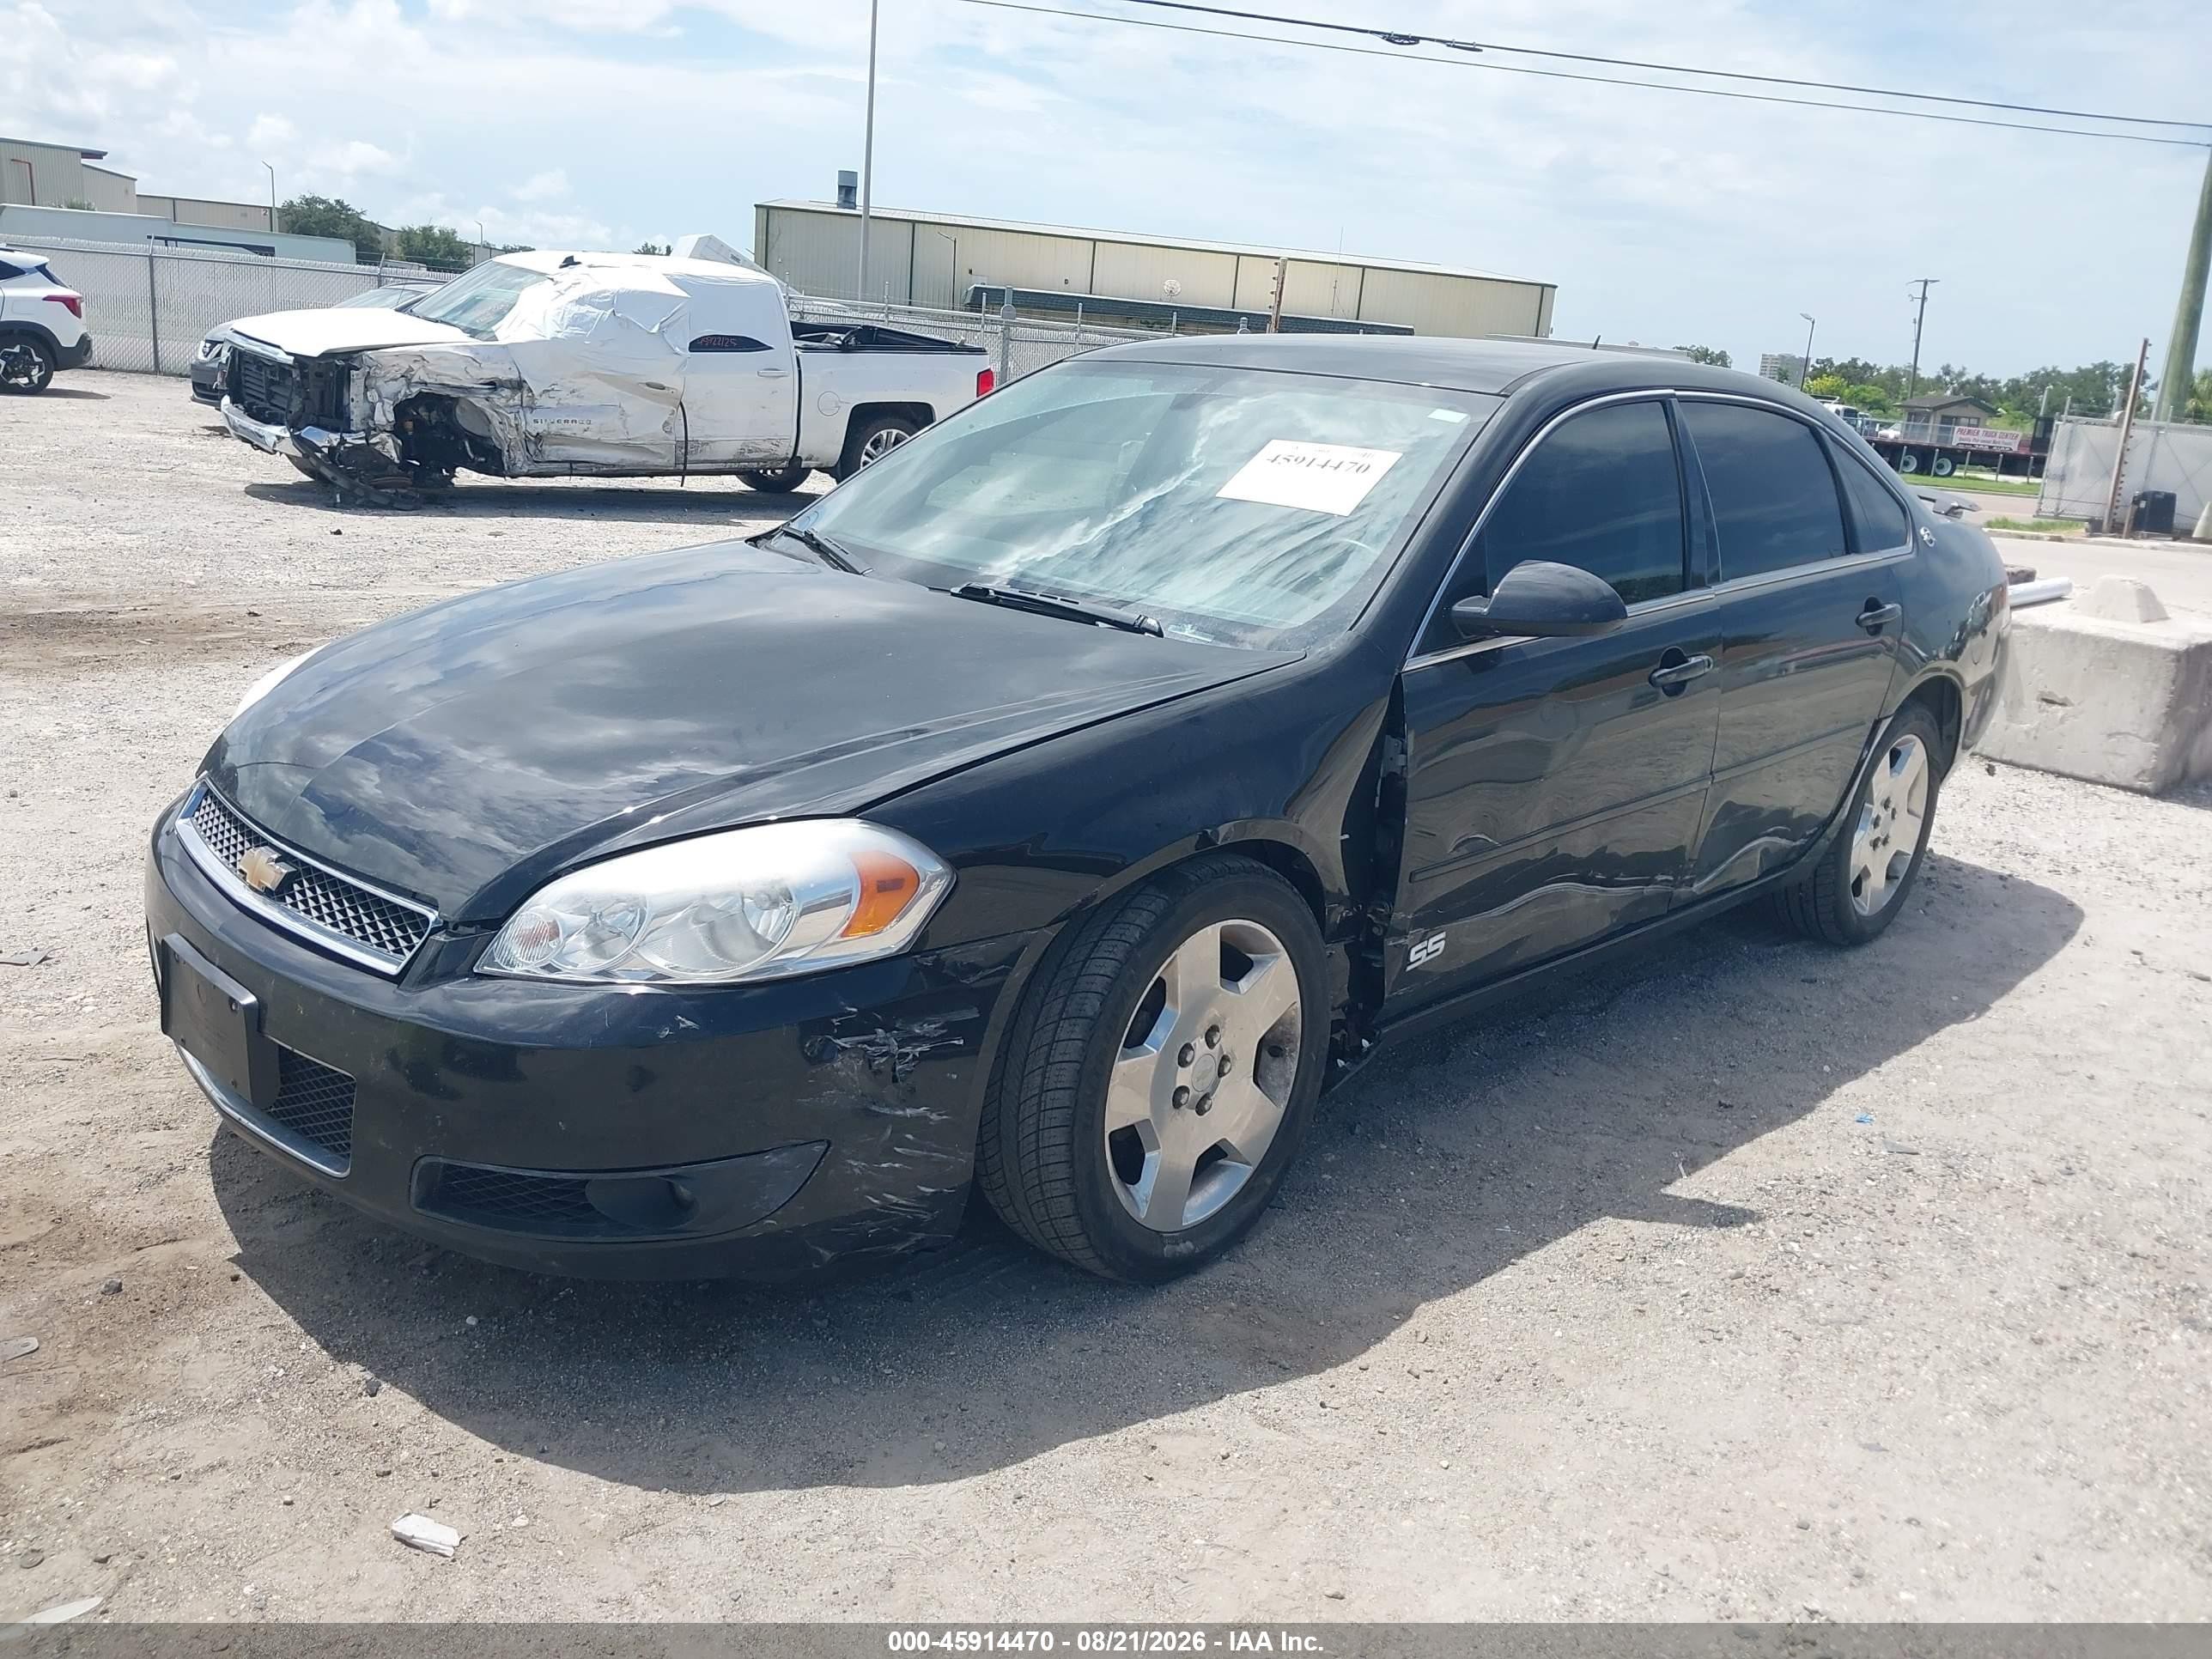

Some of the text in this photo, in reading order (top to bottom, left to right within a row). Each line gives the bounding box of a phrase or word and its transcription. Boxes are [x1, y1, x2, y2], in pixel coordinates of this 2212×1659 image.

[1957, 428, 1979, 436] PREMIER
[1266, 453, 1370, 474] 45914470
[1406, 932, 1447, 972] SS
